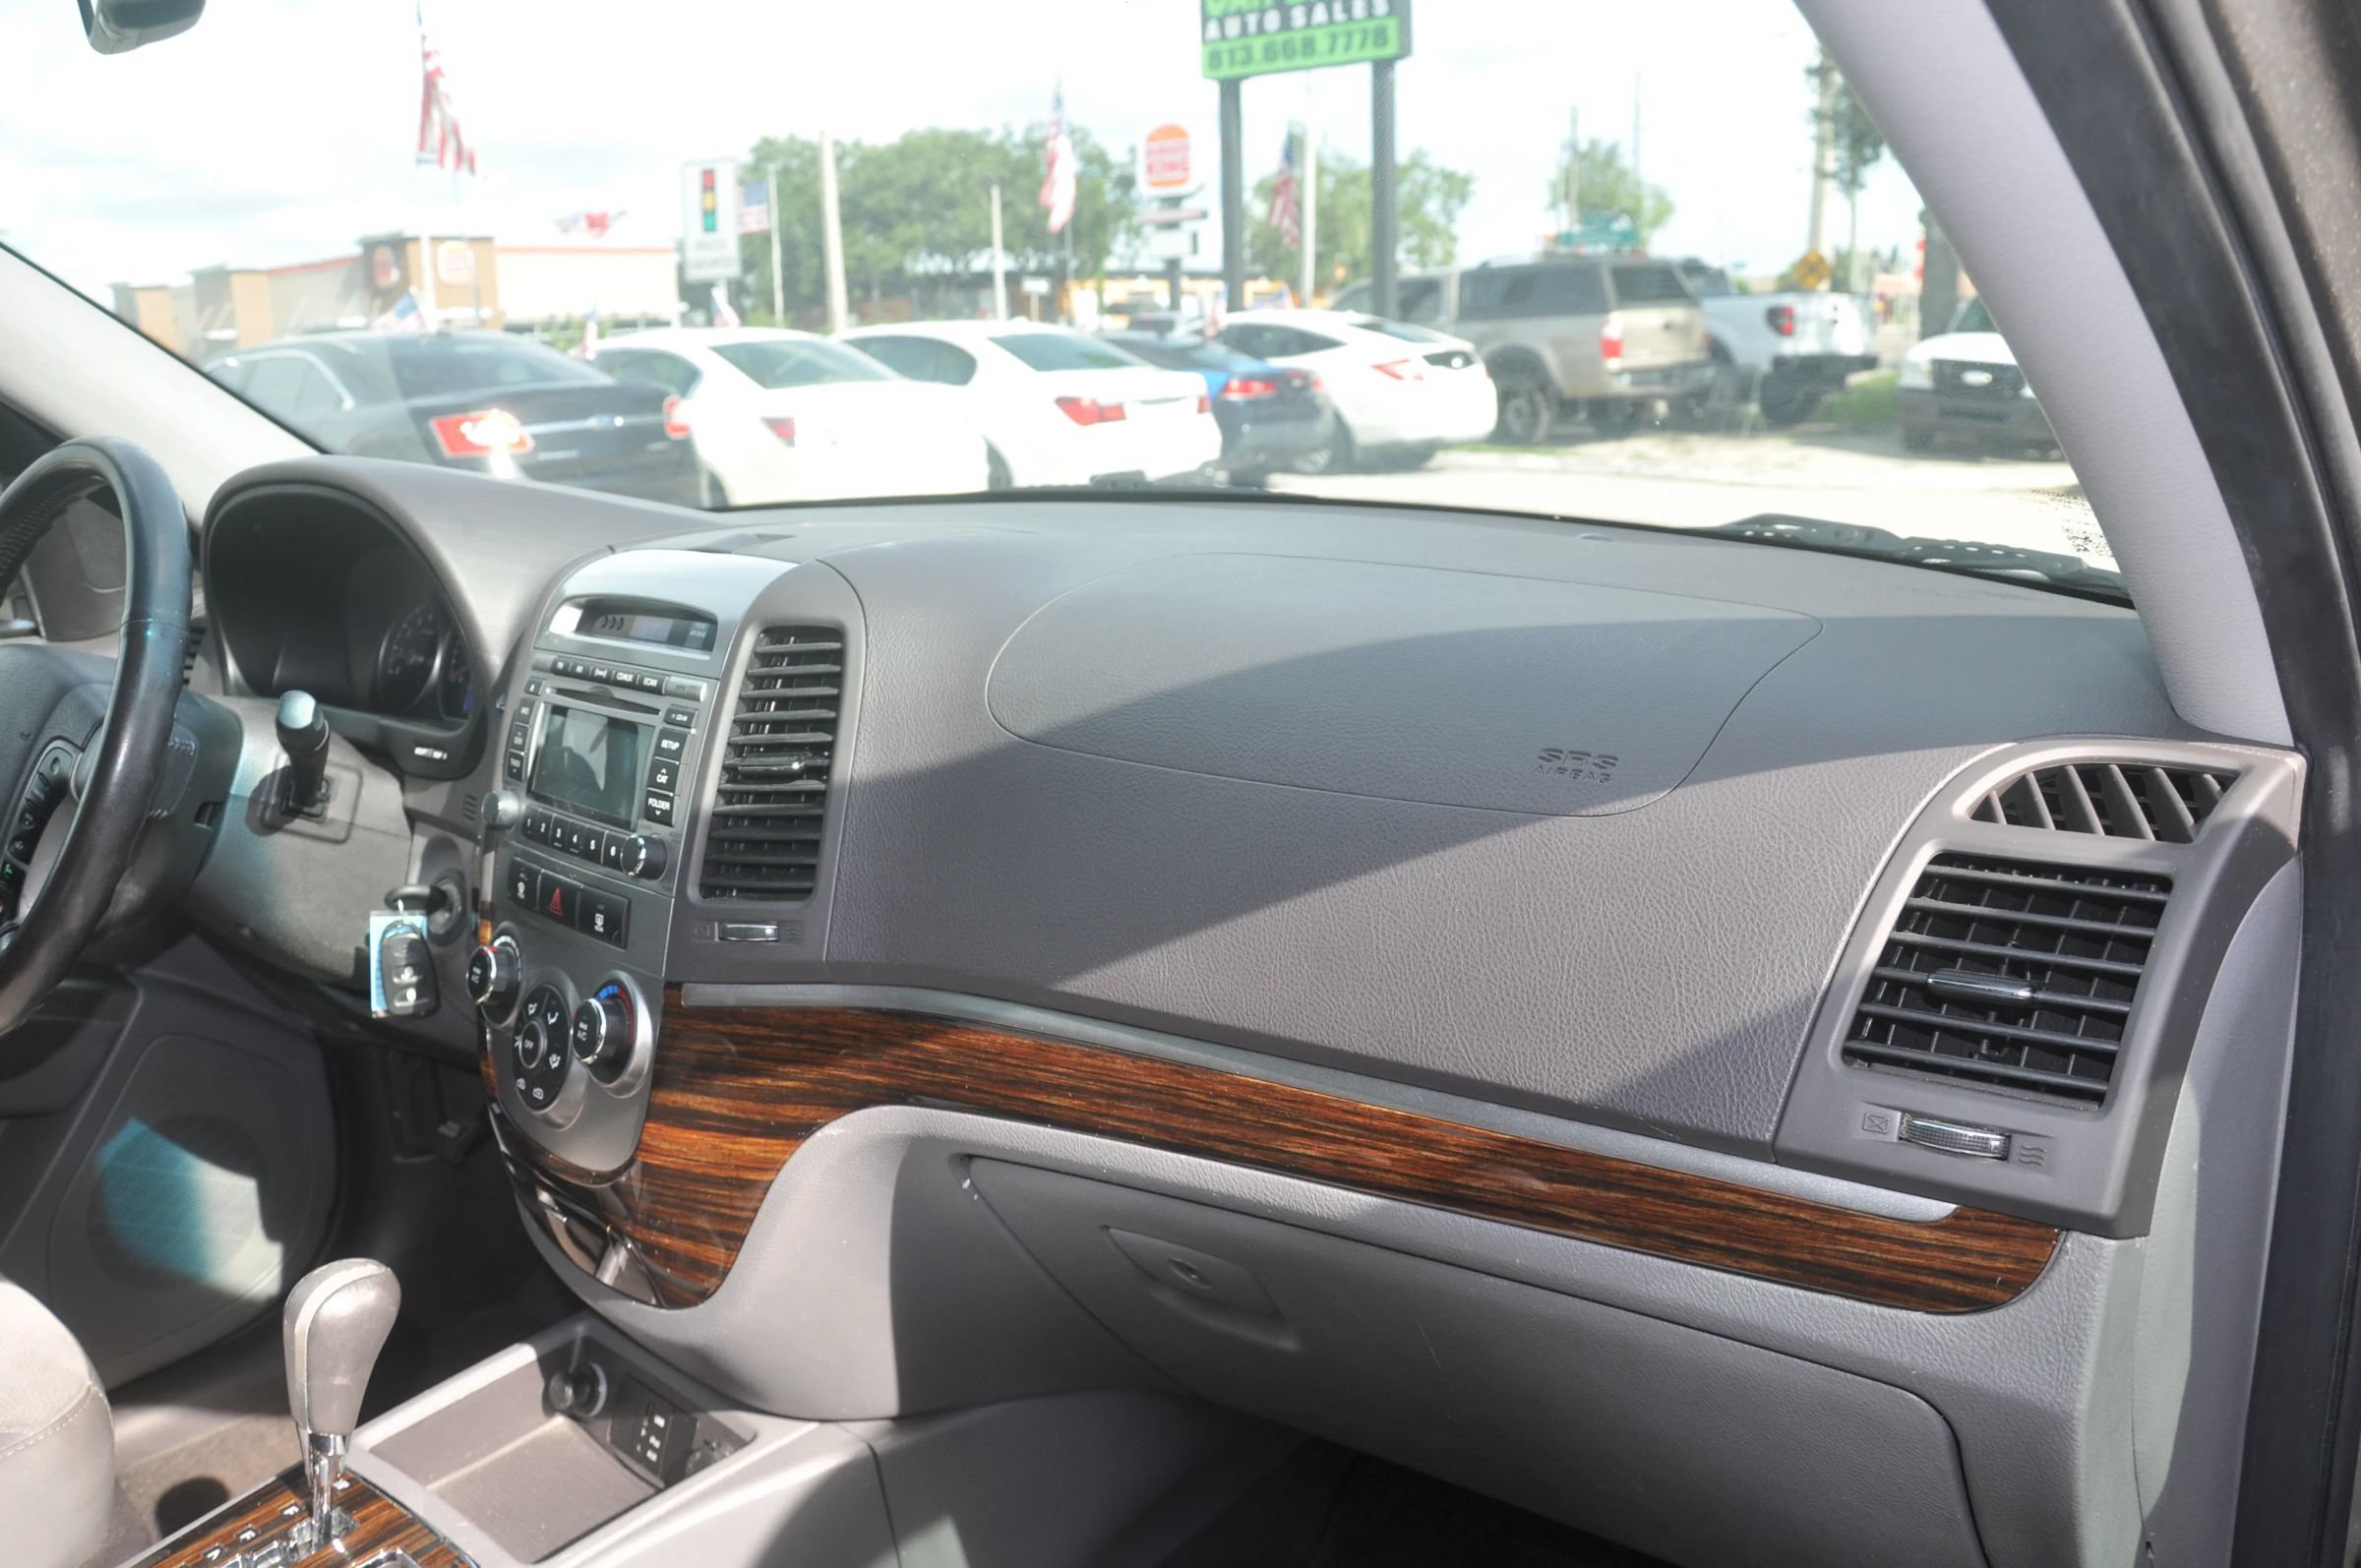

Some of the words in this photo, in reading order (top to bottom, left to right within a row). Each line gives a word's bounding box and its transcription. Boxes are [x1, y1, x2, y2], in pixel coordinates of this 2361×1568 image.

[1204, 8, 1282, 42] AUTO
[1290, 0, 1390, 30] SALES
[642, 677, 659, 688] SCAN
[660, 739, 681, 751] SETUP
[1537, 747, 1618, 770] SRS
[1531, 764, 1610, 784] AIRBAG
[647, 797, 671, 811] FOLDER
[540, 822, 546, 833] 2
[556, 827, 562, 839] 3
[573, 833, 578, 844] 4
[590, 839, 596, 851] 5
